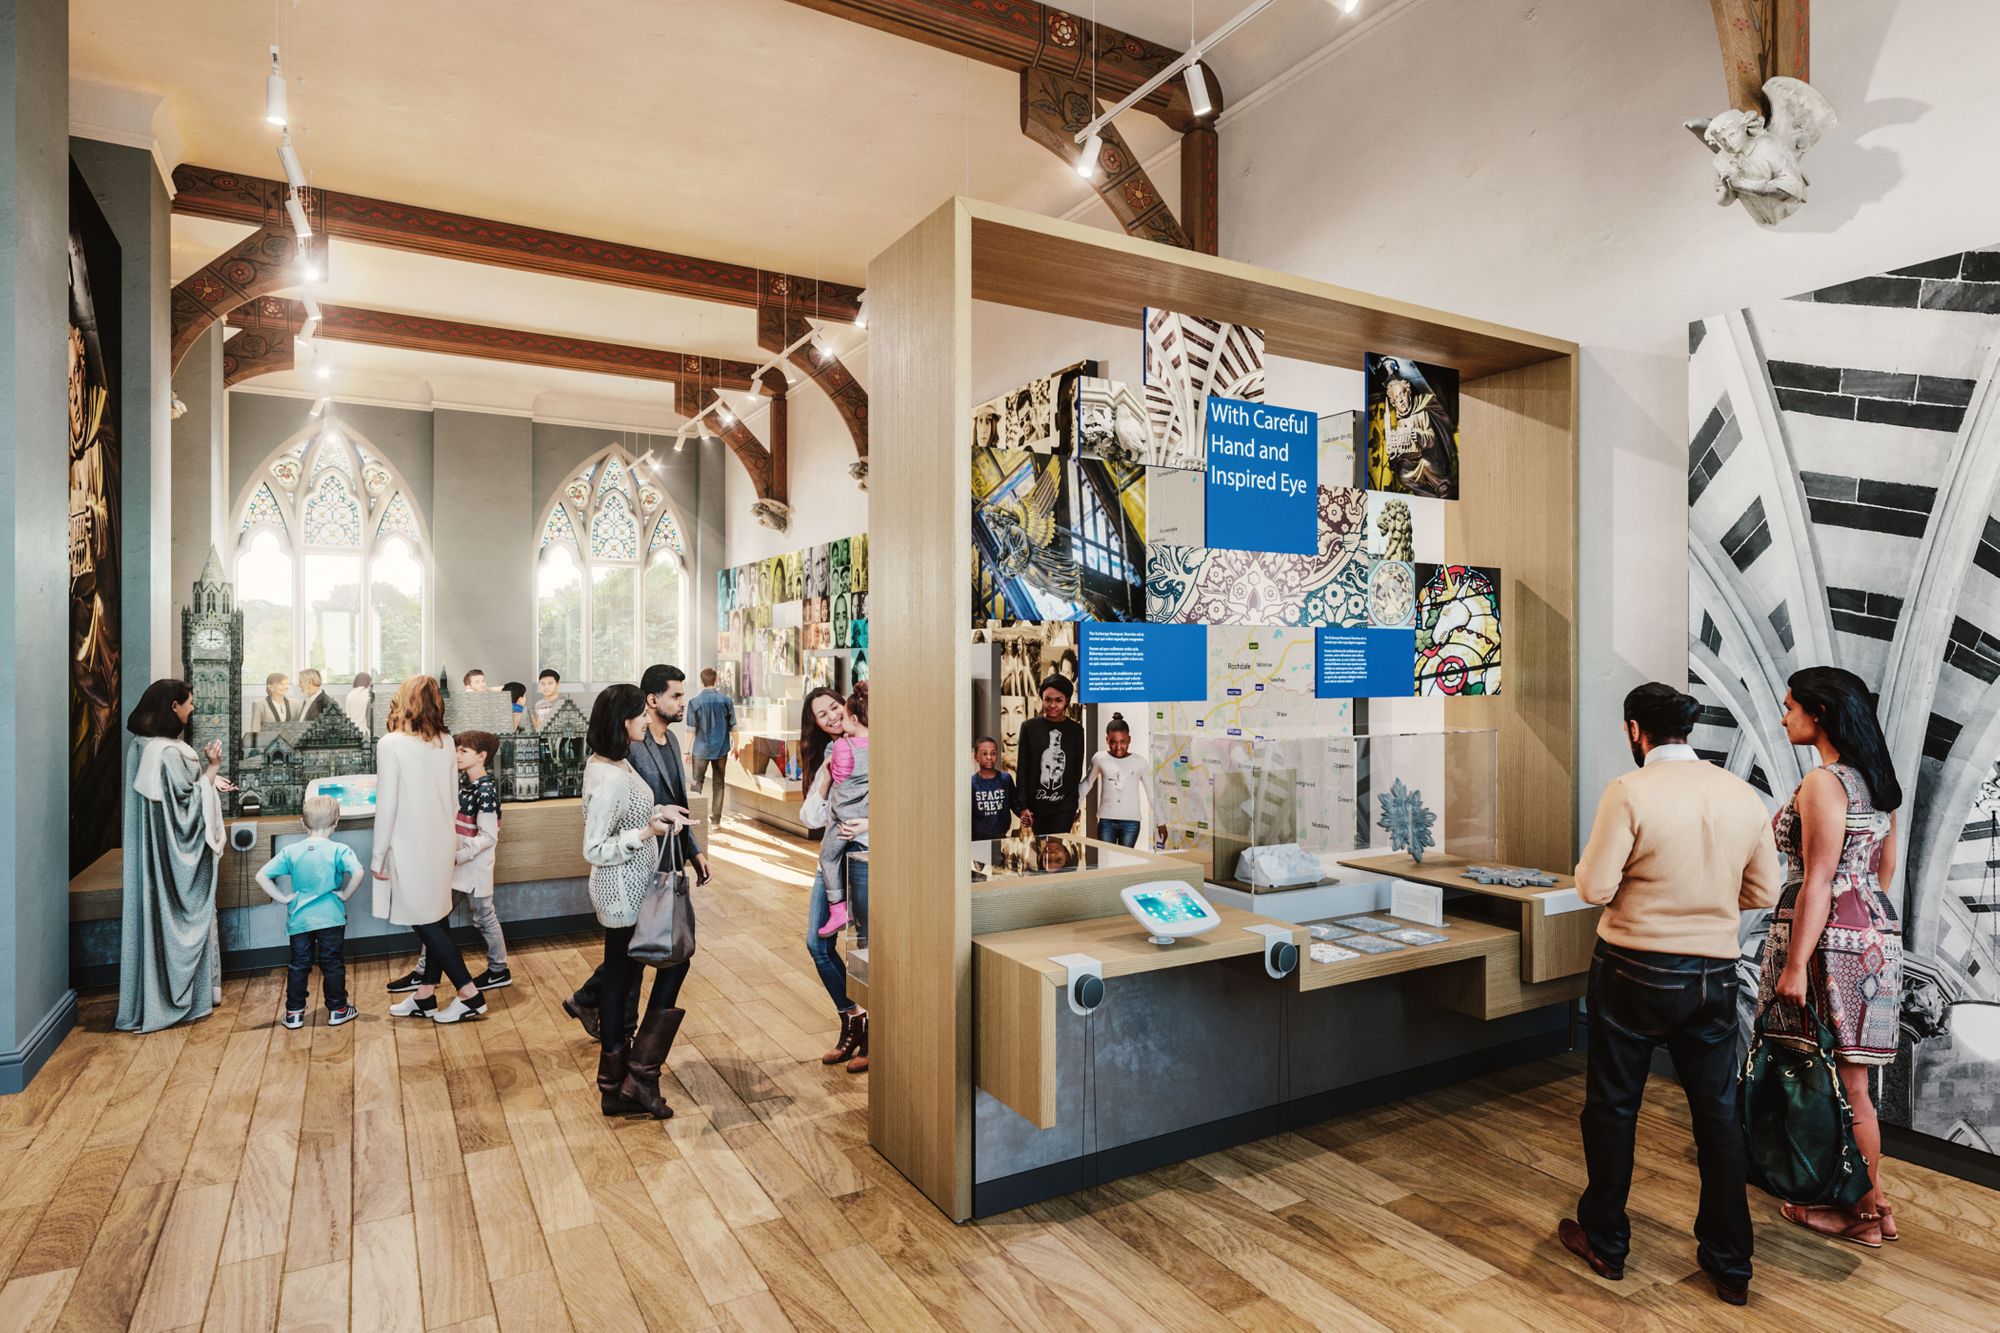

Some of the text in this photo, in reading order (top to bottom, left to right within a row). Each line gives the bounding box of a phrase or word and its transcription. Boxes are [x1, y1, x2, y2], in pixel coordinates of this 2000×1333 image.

[1211, 402, 1308, 435] With Careful
[1211, 433, 1289, 462] Hand and
[1211, 465, 1307, 497] Inspired Eye
[975, 789, 1006, 802] SPACE
[977, 800, 1004, 812] CREW
